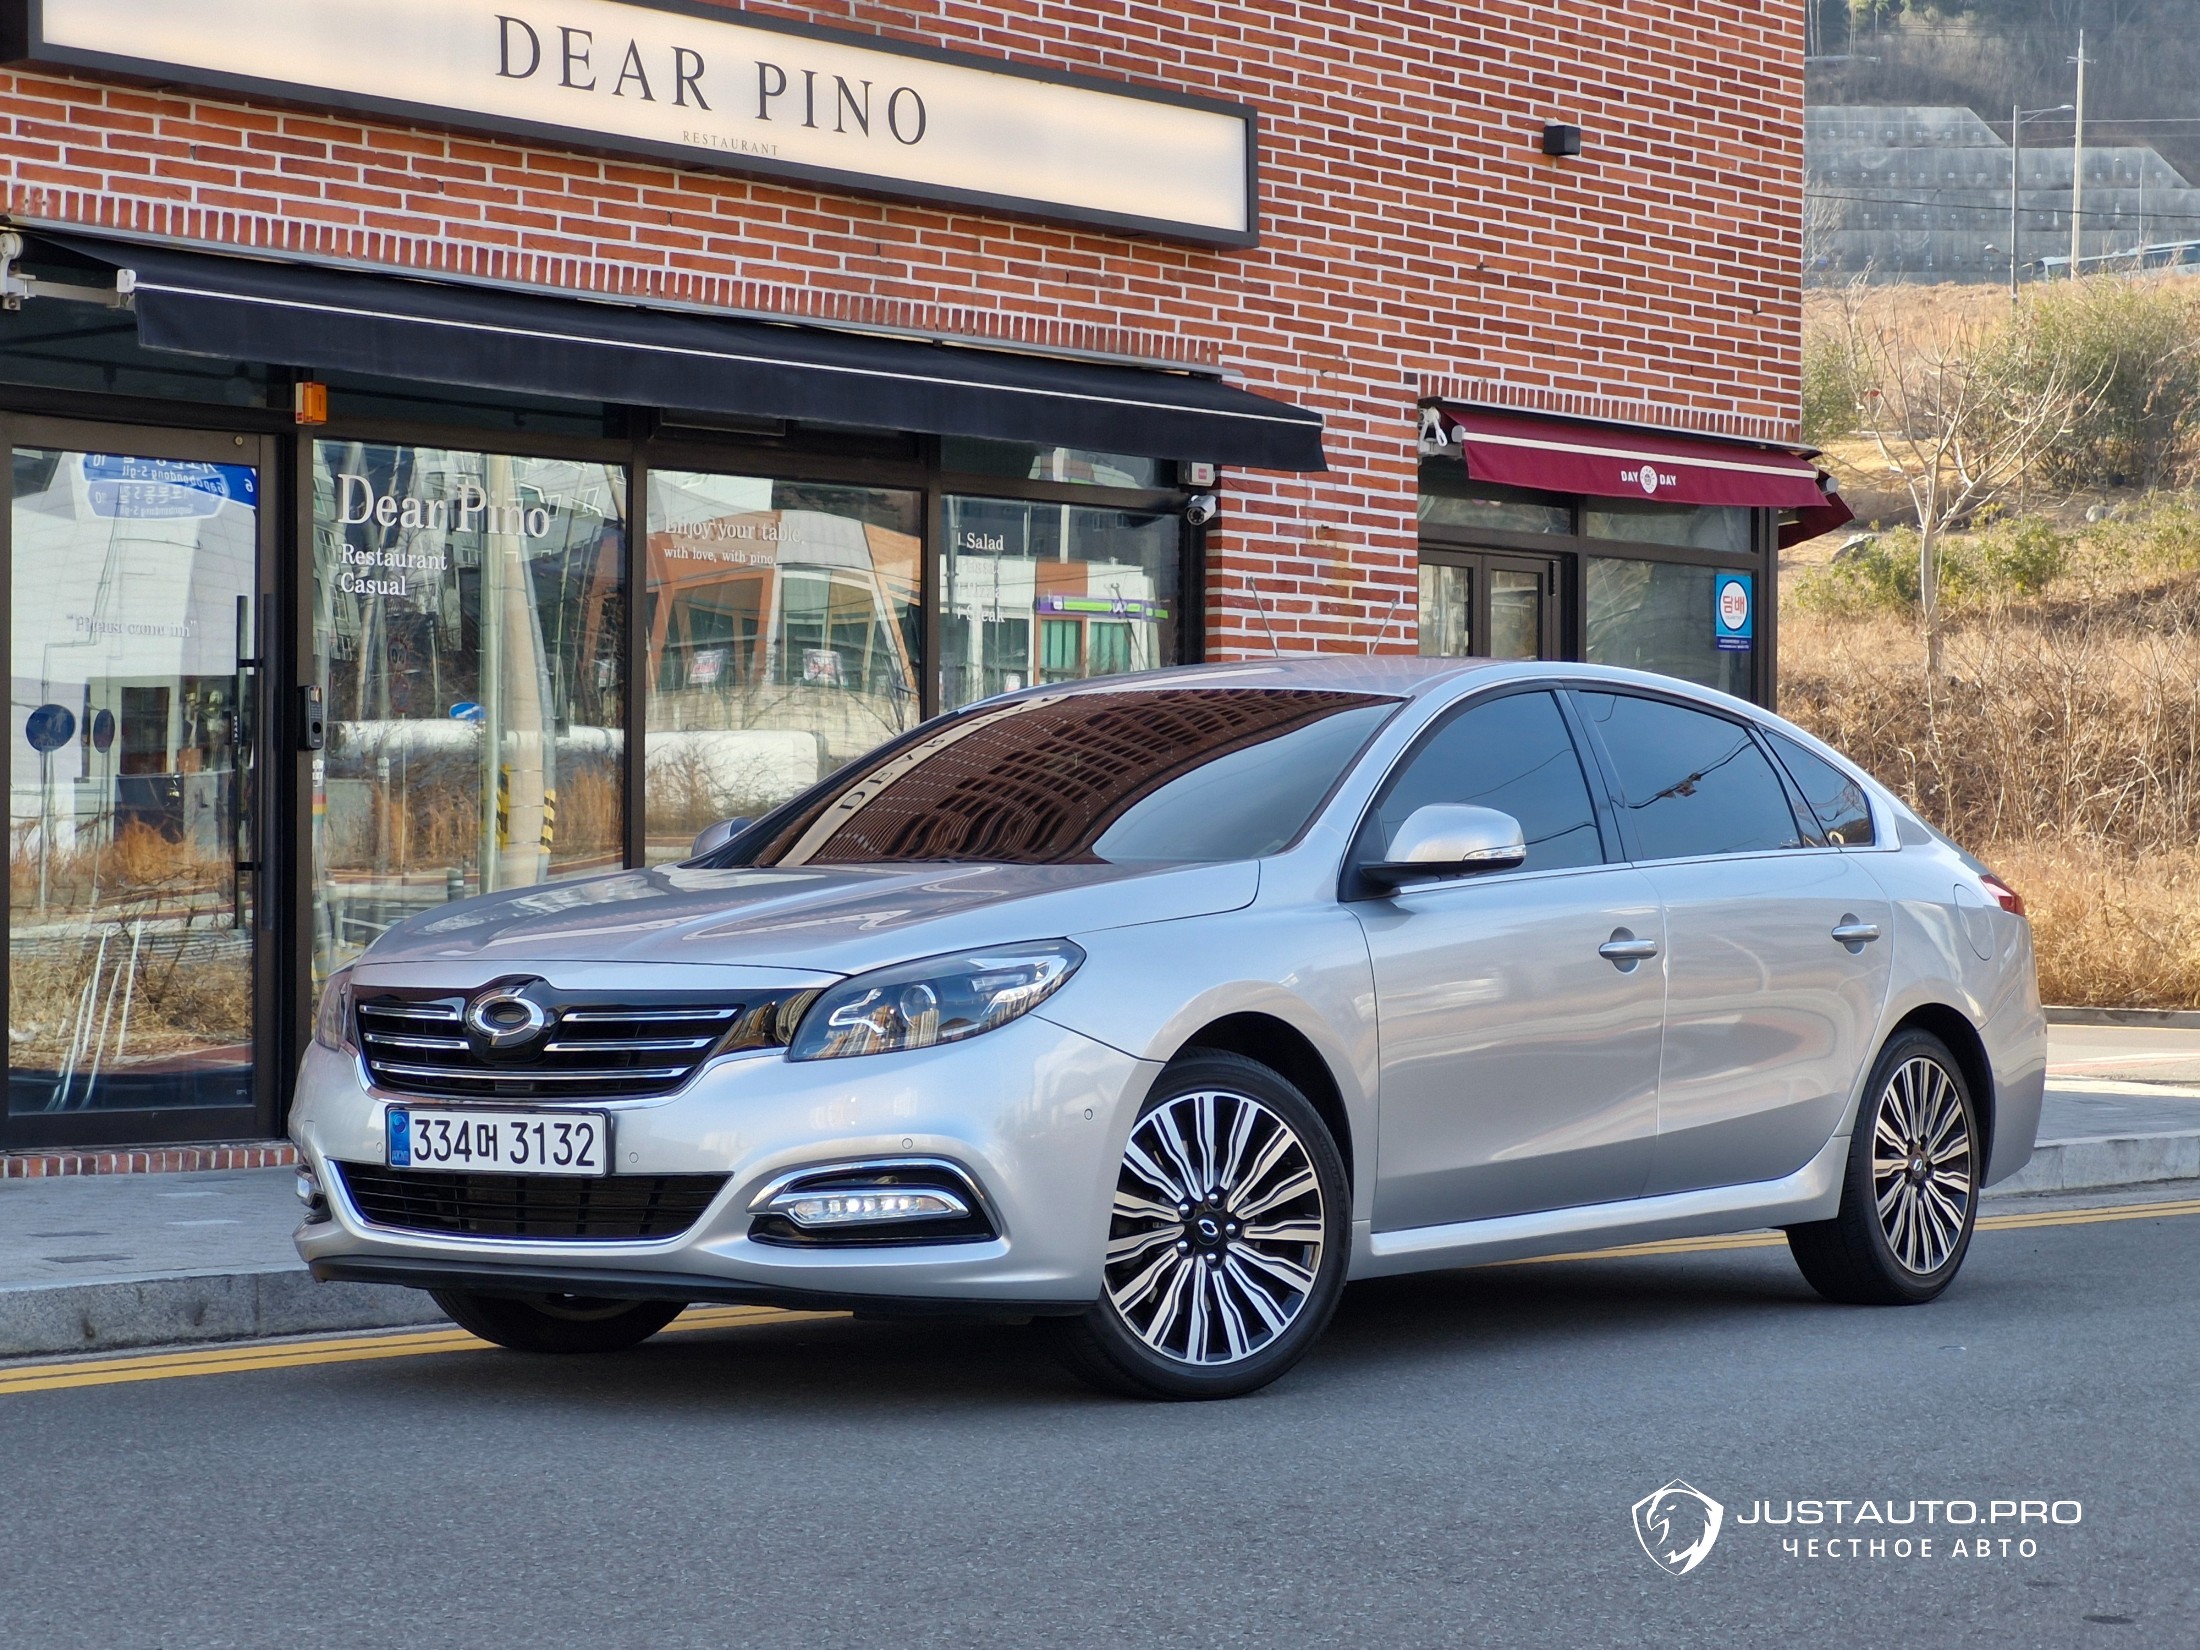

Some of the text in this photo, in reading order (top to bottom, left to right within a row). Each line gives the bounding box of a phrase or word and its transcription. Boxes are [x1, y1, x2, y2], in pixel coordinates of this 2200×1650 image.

[494, 14, 927, 146] DEAR PINO
[682, 130, 779, 156] RESTAURANT
[1621, 470, 1638, 482] DAY
[1659, 474, 1676, 486] DAY
[338, 473, 550, 538] Dear Pino
[665, 518, 805, 544] Enjoy your table.
[966, 532, 1004, 551] Salad
[341, 543, 448, 571] Restaurant
[664, 546, 688, 560] with
[692, 547, 717, 562] love,
[722, 550, 746, 563] with
[340, 572, 407, 596] Casual
[966, 604, 1006, 623] Seak
[1723, 595, 1745, 614] 담배
[413, 1119, 595, 1167] 334머 3132
